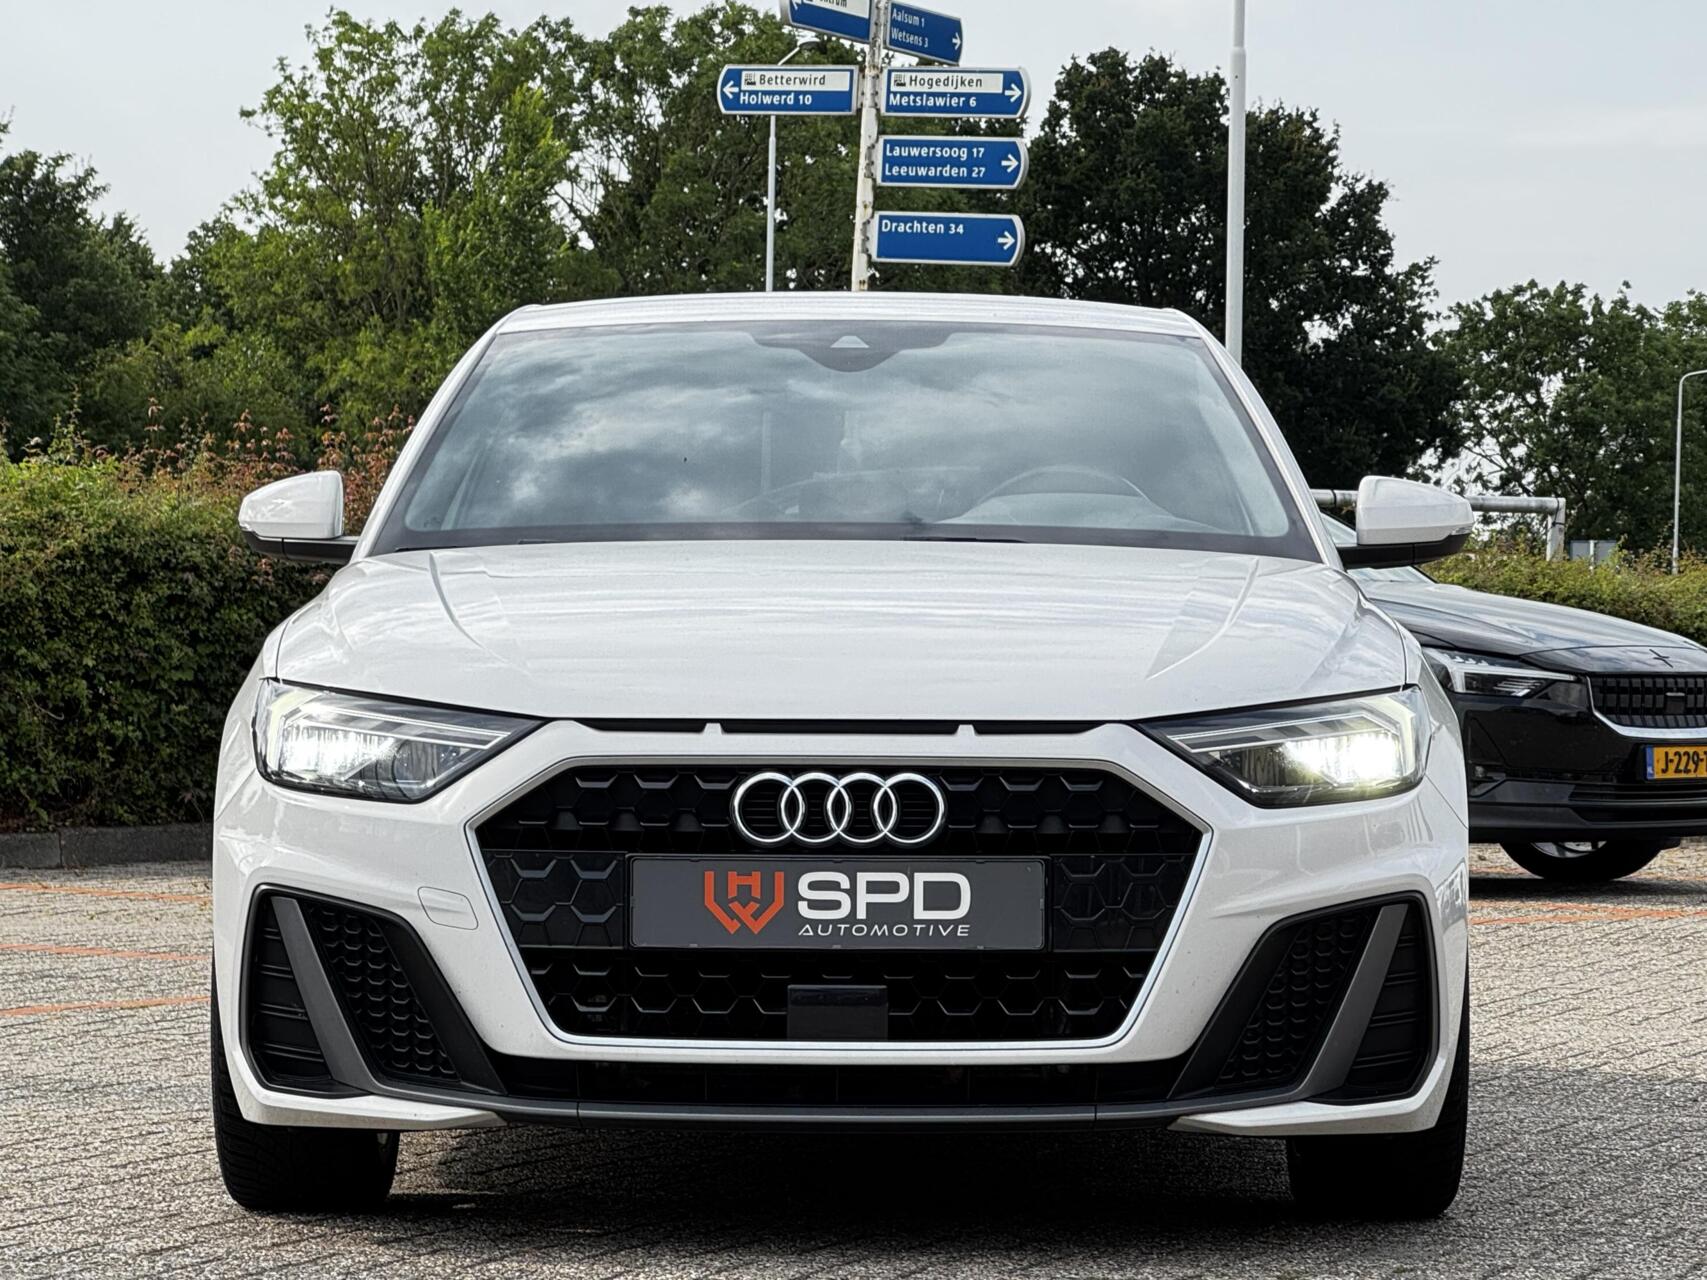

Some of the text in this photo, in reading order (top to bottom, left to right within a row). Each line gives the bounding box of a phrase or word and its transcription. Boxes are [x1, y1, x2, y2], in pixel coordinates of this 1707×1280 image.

[892, 8, 926, 28] Aalsum 1
[891, 26, 929, 48] Wetsens 3
[759, 74, 826, 86] Betterwird
[909, 75, 983, 90] Hogedijken
[740, 92, 813, 105] Holwerd 10
[889, 93, 977, 107] Metslawier 6
[886, 143, 985, 161] Lauwersoog 17
[885, 163, 986, 178] Leeuwarden 27
[881, 219, 965, 234] Drachten 34
[798, 871, 972, 920] SPD
[798, 924, 971, 937] AUTOMOTIVE
